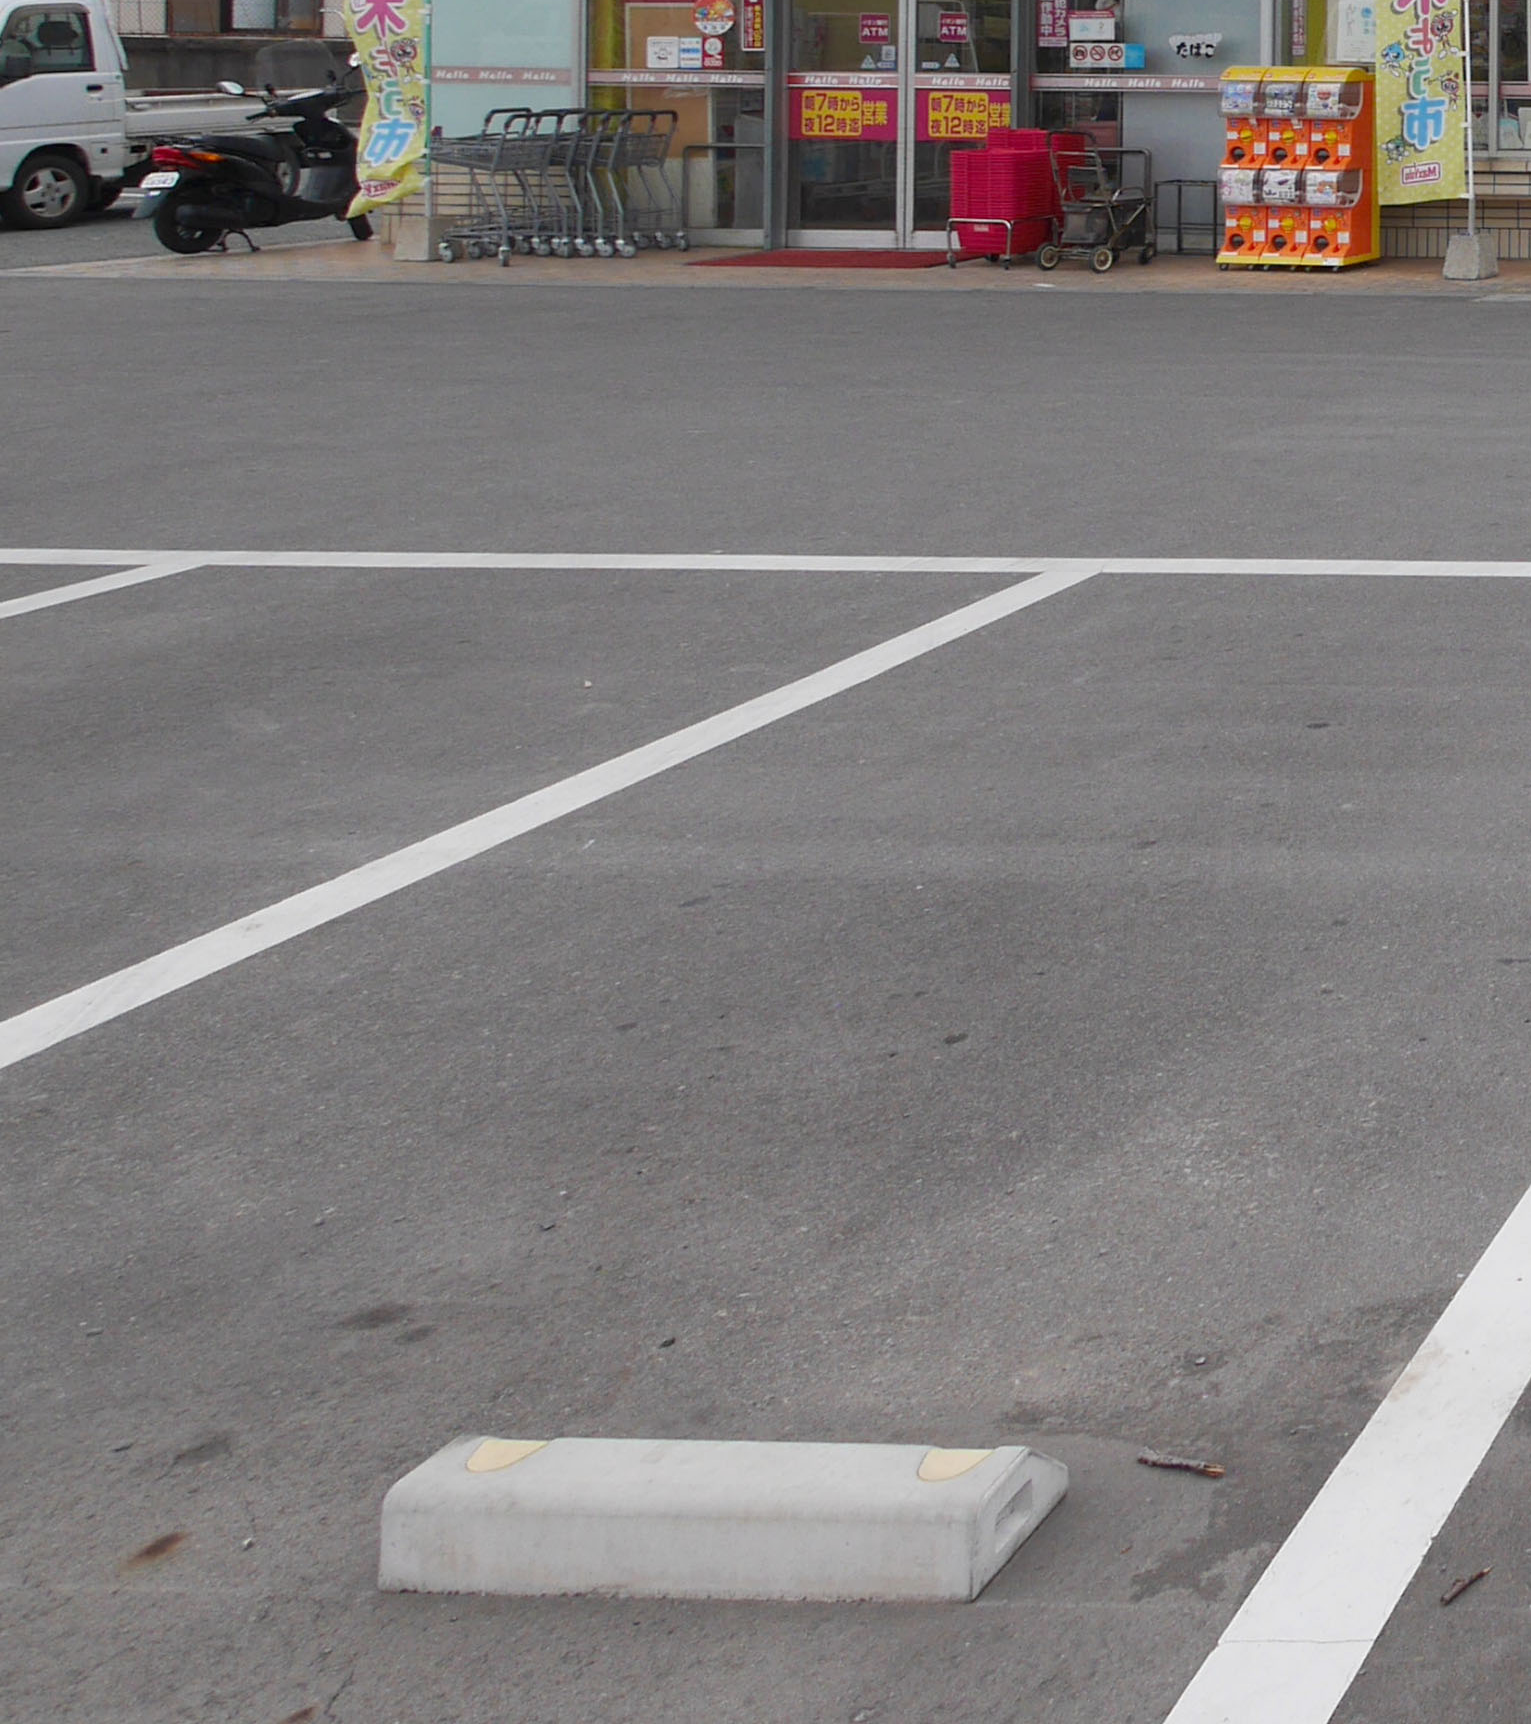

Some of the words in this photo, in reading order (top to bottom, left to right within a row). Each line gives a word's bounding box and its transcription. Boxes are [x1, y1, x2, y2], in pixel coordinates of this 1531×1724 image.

[861, 27, 889, 36] ATM
[940, 26, 968, 36] ATM
[1175, 41, 1216, 58] たばこ
[435, 70, 470, 80] Hallo
[479, 71, 513, 81] Hallo
[522, 72, 556, 82] Hallo
[622, 73, 655, 83] Hallo
[666, 73, 700, 83] Hallo
[710, 74, 743, 84] Hallo
[804, 76, 838, 85] Hallo
[848, 76, 882, 86] Hallo
[931, 77, 965, 86] Hallo
[975, 77, 1010, 87] Hallo
[1084, 78, 1118, 88] Hallo
[1127, 78, 1162, 88] Hallo
[1171, 78, 1205, 88] Hallo
[803, 92, 861, 112] 朝7時から
[930, 94, 988, 113] 朝7時から
[861, 100, 888, 126] 営業
[988, 102, 1011, 128] 営業
[803, 115, 861, 134] 夜12時迄
[930, 116, 988, 135] 夜12時迄
